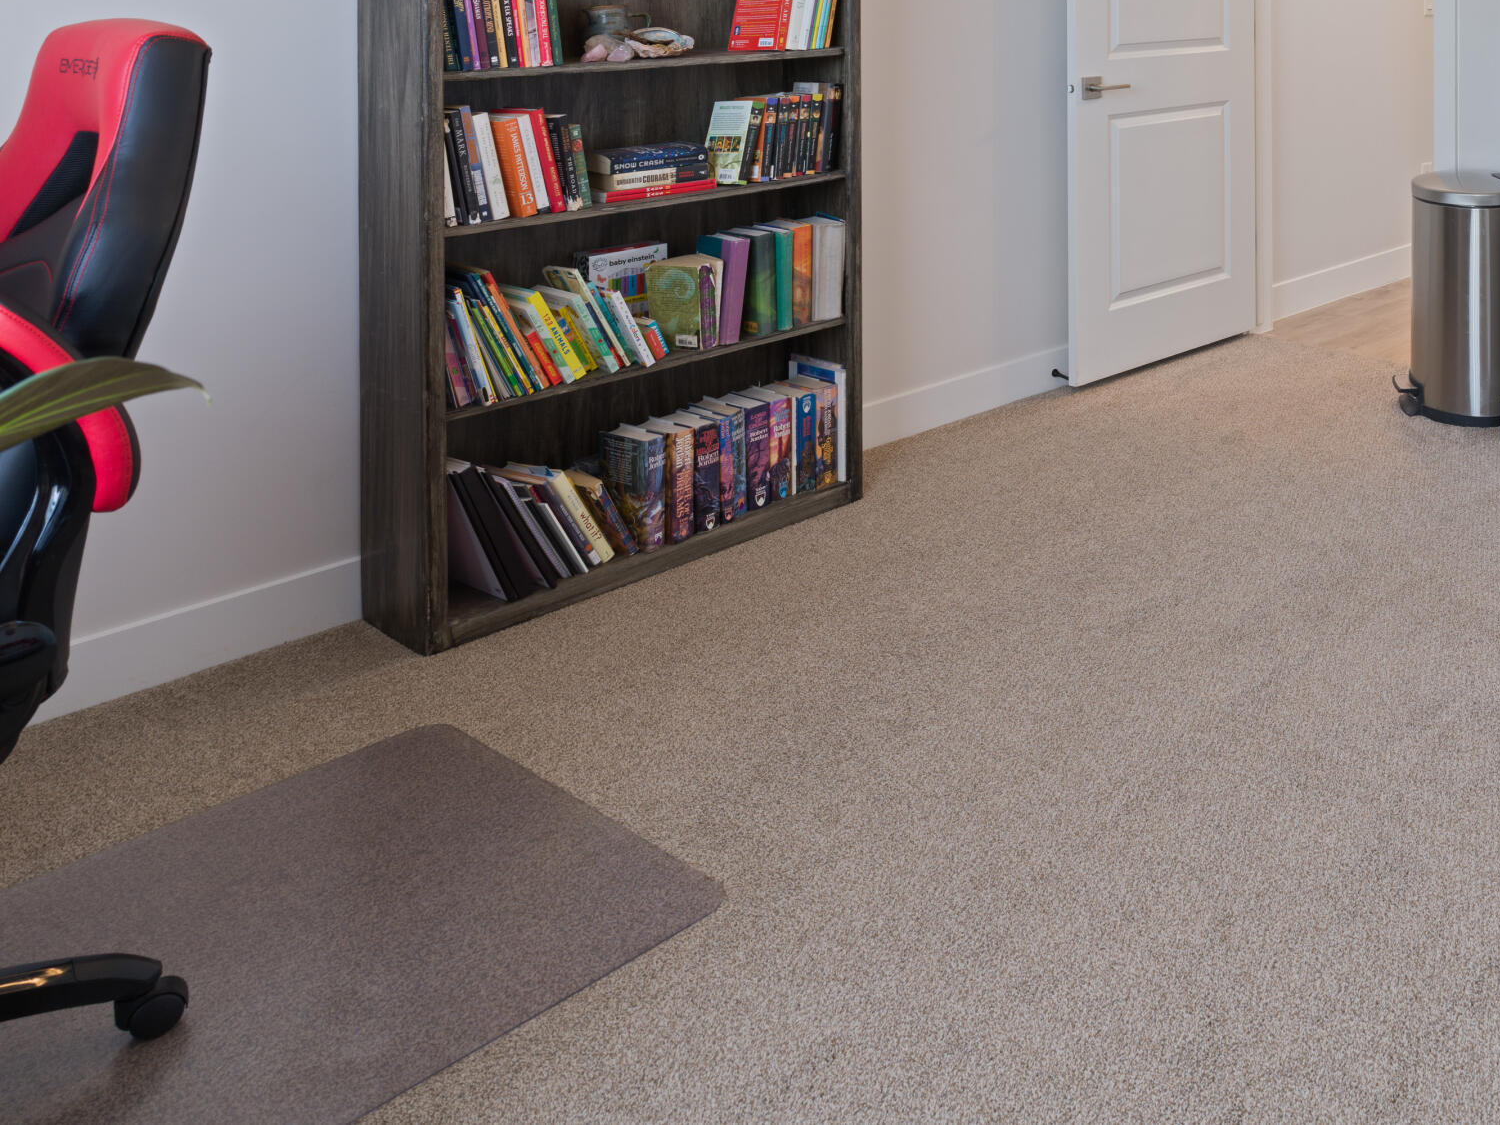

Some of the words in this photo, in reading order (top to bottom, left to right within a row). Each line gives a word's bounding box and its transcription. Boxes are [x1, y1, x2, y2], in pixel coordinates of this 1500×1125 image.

[456, 129, 466, 156] MARK
[510, 133, 521, 153] JAMES
[515, 154, 529, 191] PATTERSON
[614, 162, 637, 171] SNOW
[639, 159, 664, 167] CRASH
[642, 173, 669, 183] COURAGE
[520, 192, 534, 206] 13
[609, 258, 626, 267] baby
[628, 254, 655, 263] einstein
[543, 313, 552, 326] 123
[551, 326, 571, 355] ANIMALS
[630, 324, 640, 342] Colors
[675, 437, 683, 468] Jordan
[684, 434, 692, 465] Robert
[580, 511, 595, 534] what
